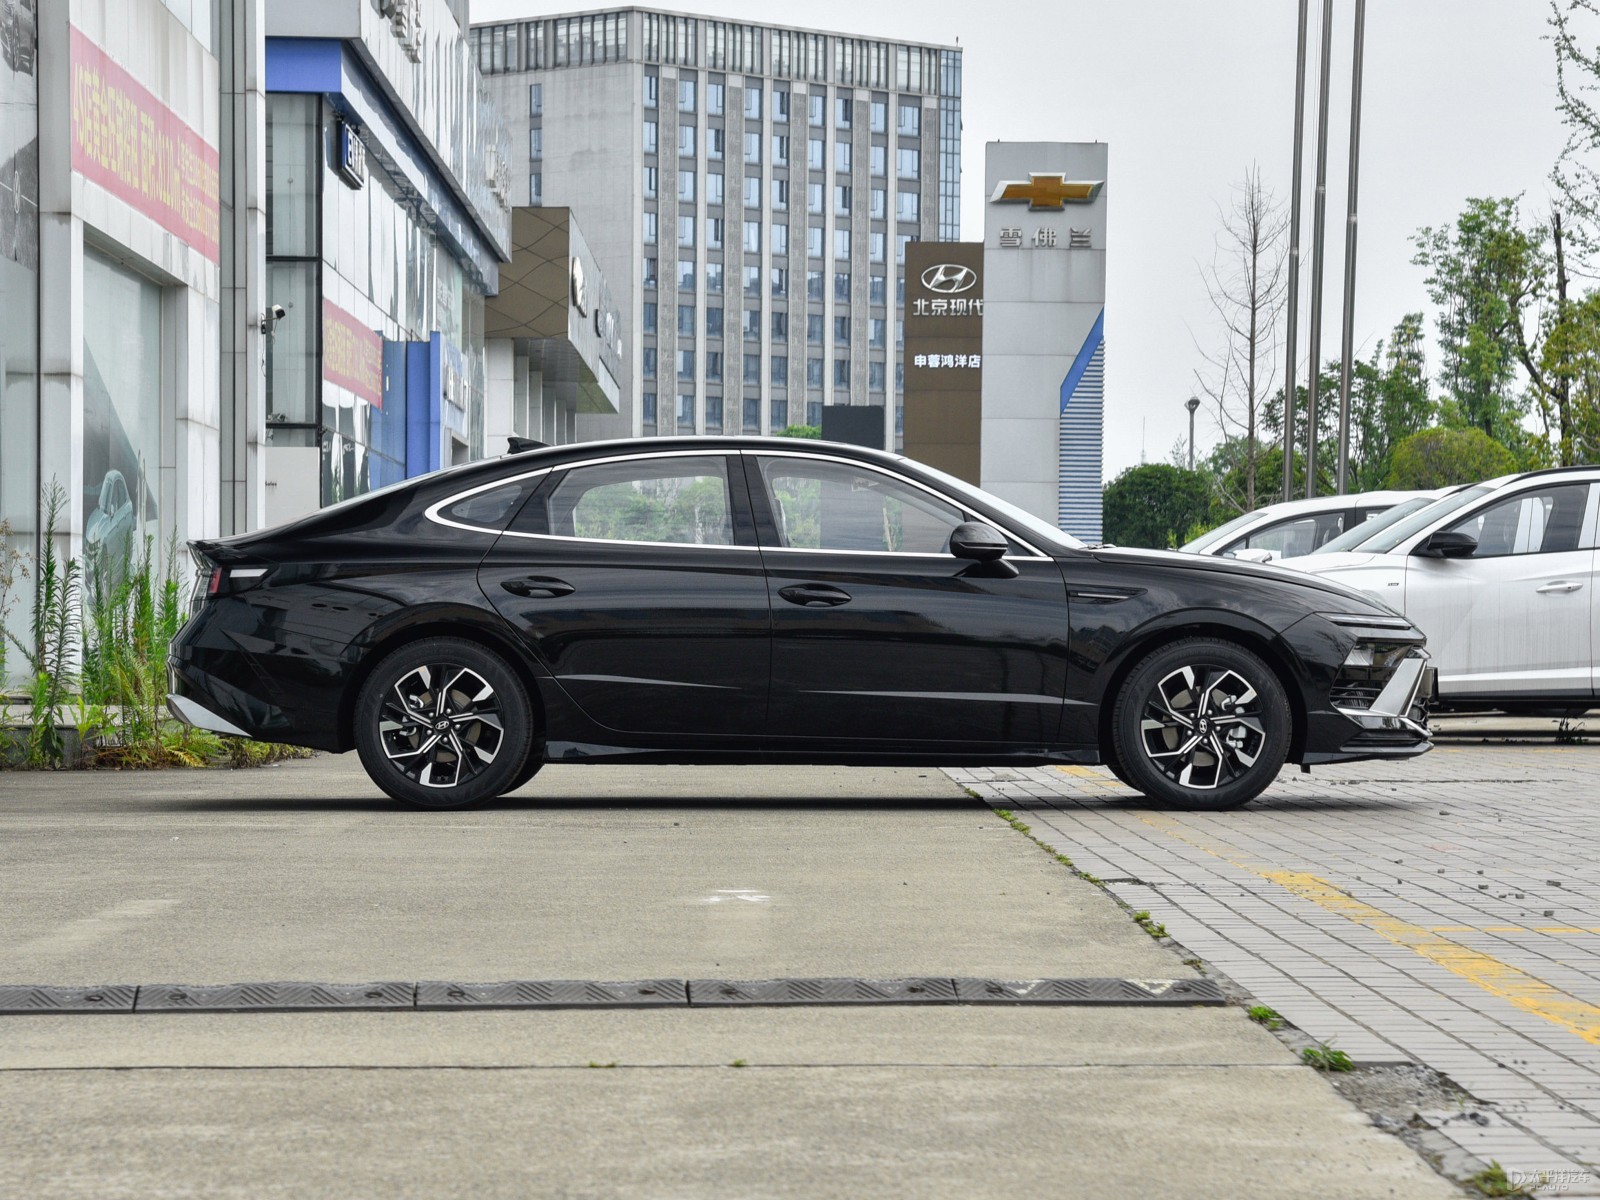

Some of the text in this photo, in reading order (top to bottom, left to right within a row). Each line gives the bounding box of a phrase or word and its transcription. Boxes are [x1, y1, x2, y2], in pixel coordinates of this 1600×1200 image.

[1000, 227, 1092, 248] 雪佛兰
[913, 298, 984, 316] 北京现代
